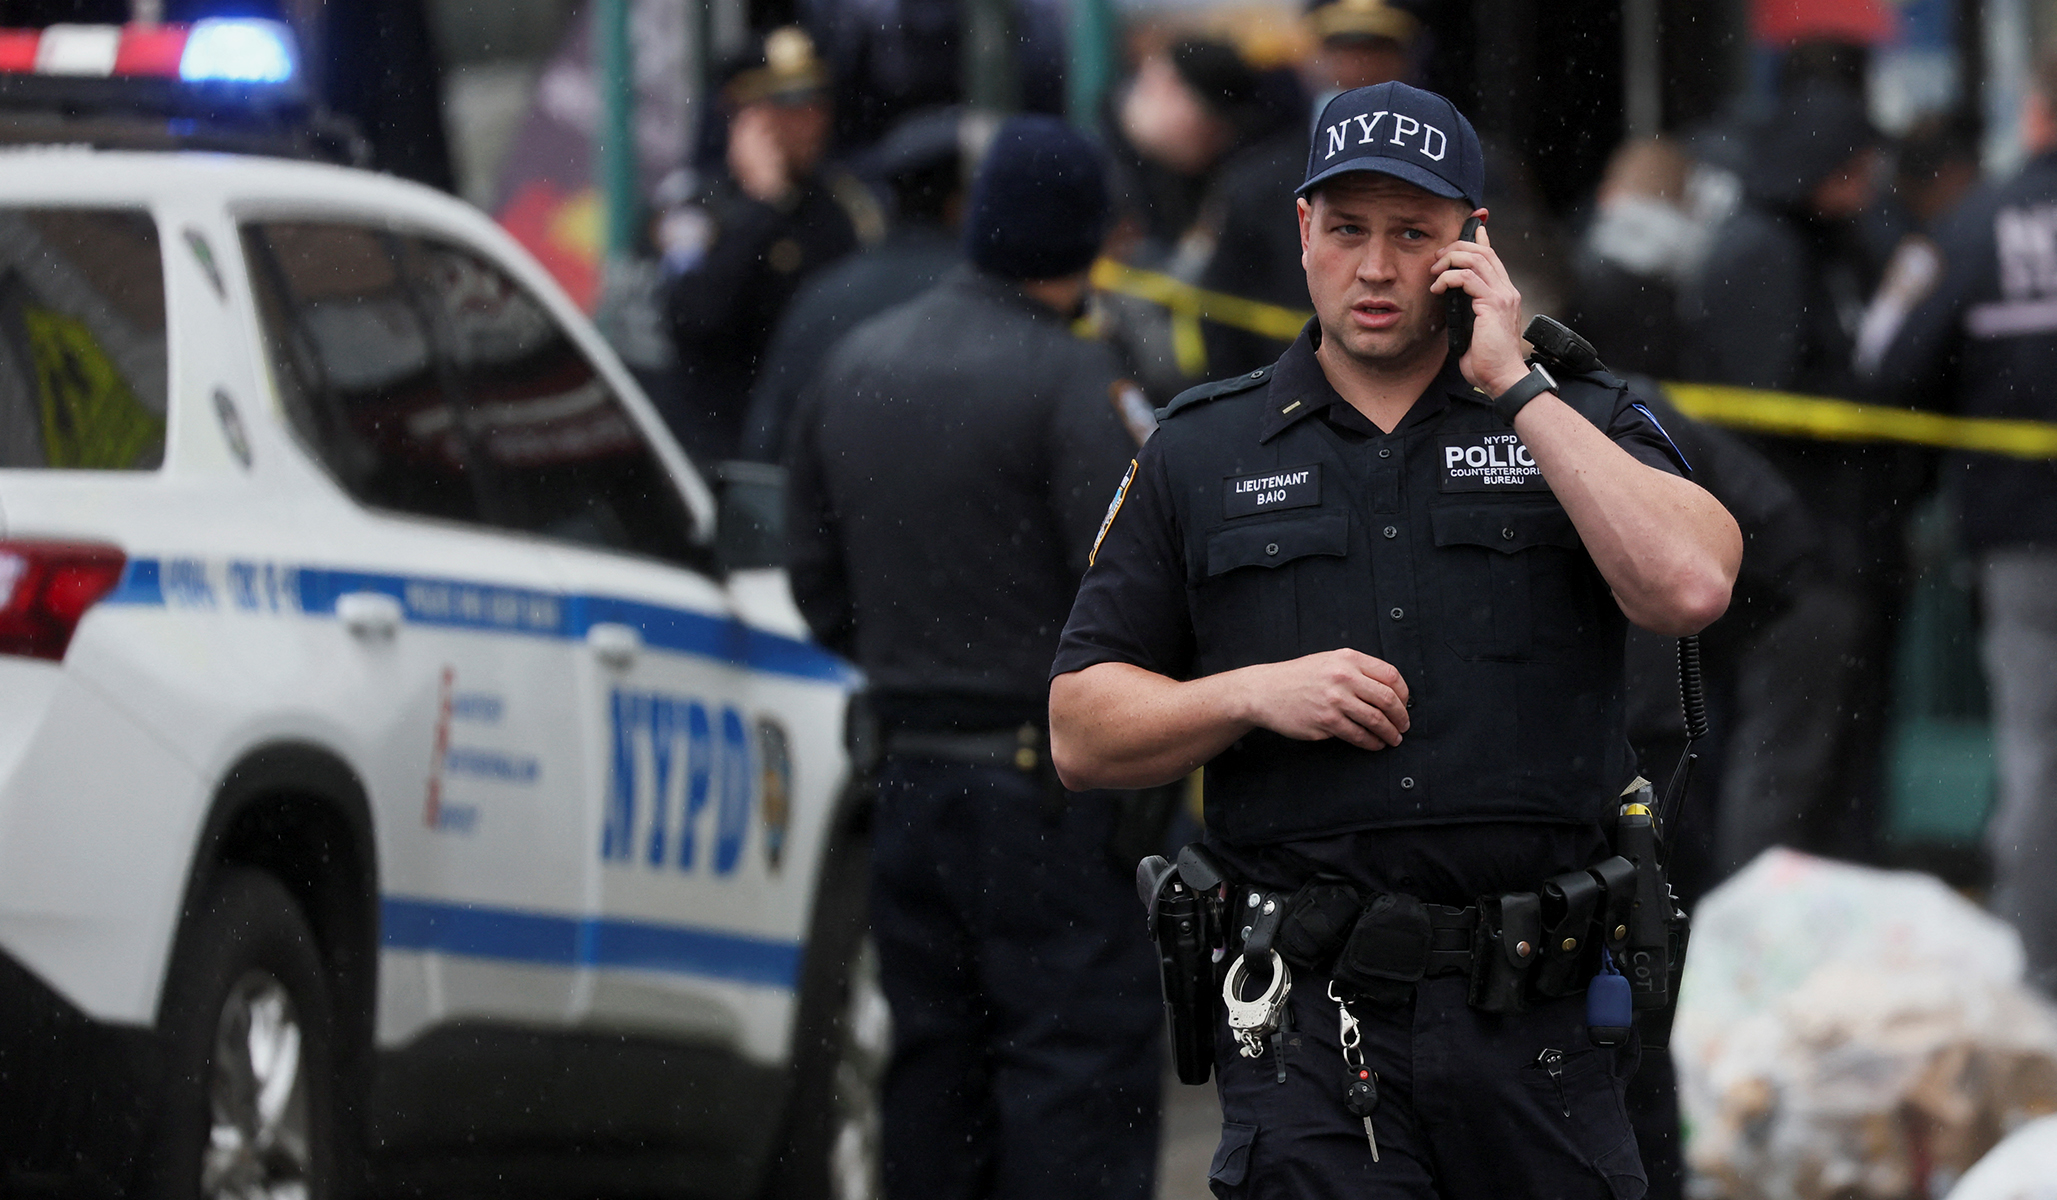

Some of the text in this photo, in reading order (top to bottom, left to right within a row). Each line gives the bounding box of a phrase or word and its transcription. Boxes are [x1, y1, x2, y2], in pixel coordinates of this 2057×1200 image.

[1325, 111, 1447, 161] NYPD
[1484, 435, 1518, 445] NYPD
[1445, 444, 1536, 469] POLIC
[1235, 471, 1309, 493] LIEUTENANT
[1450, 467, 1542, 477] COUNTERTERRORI
[1483, 476, 1525, 485] BUREAU
[1256, 489, 1287, 505] BAIO
[603, 688, 750, 876] NYPD
[1633, 951, 1652, 991] COT
